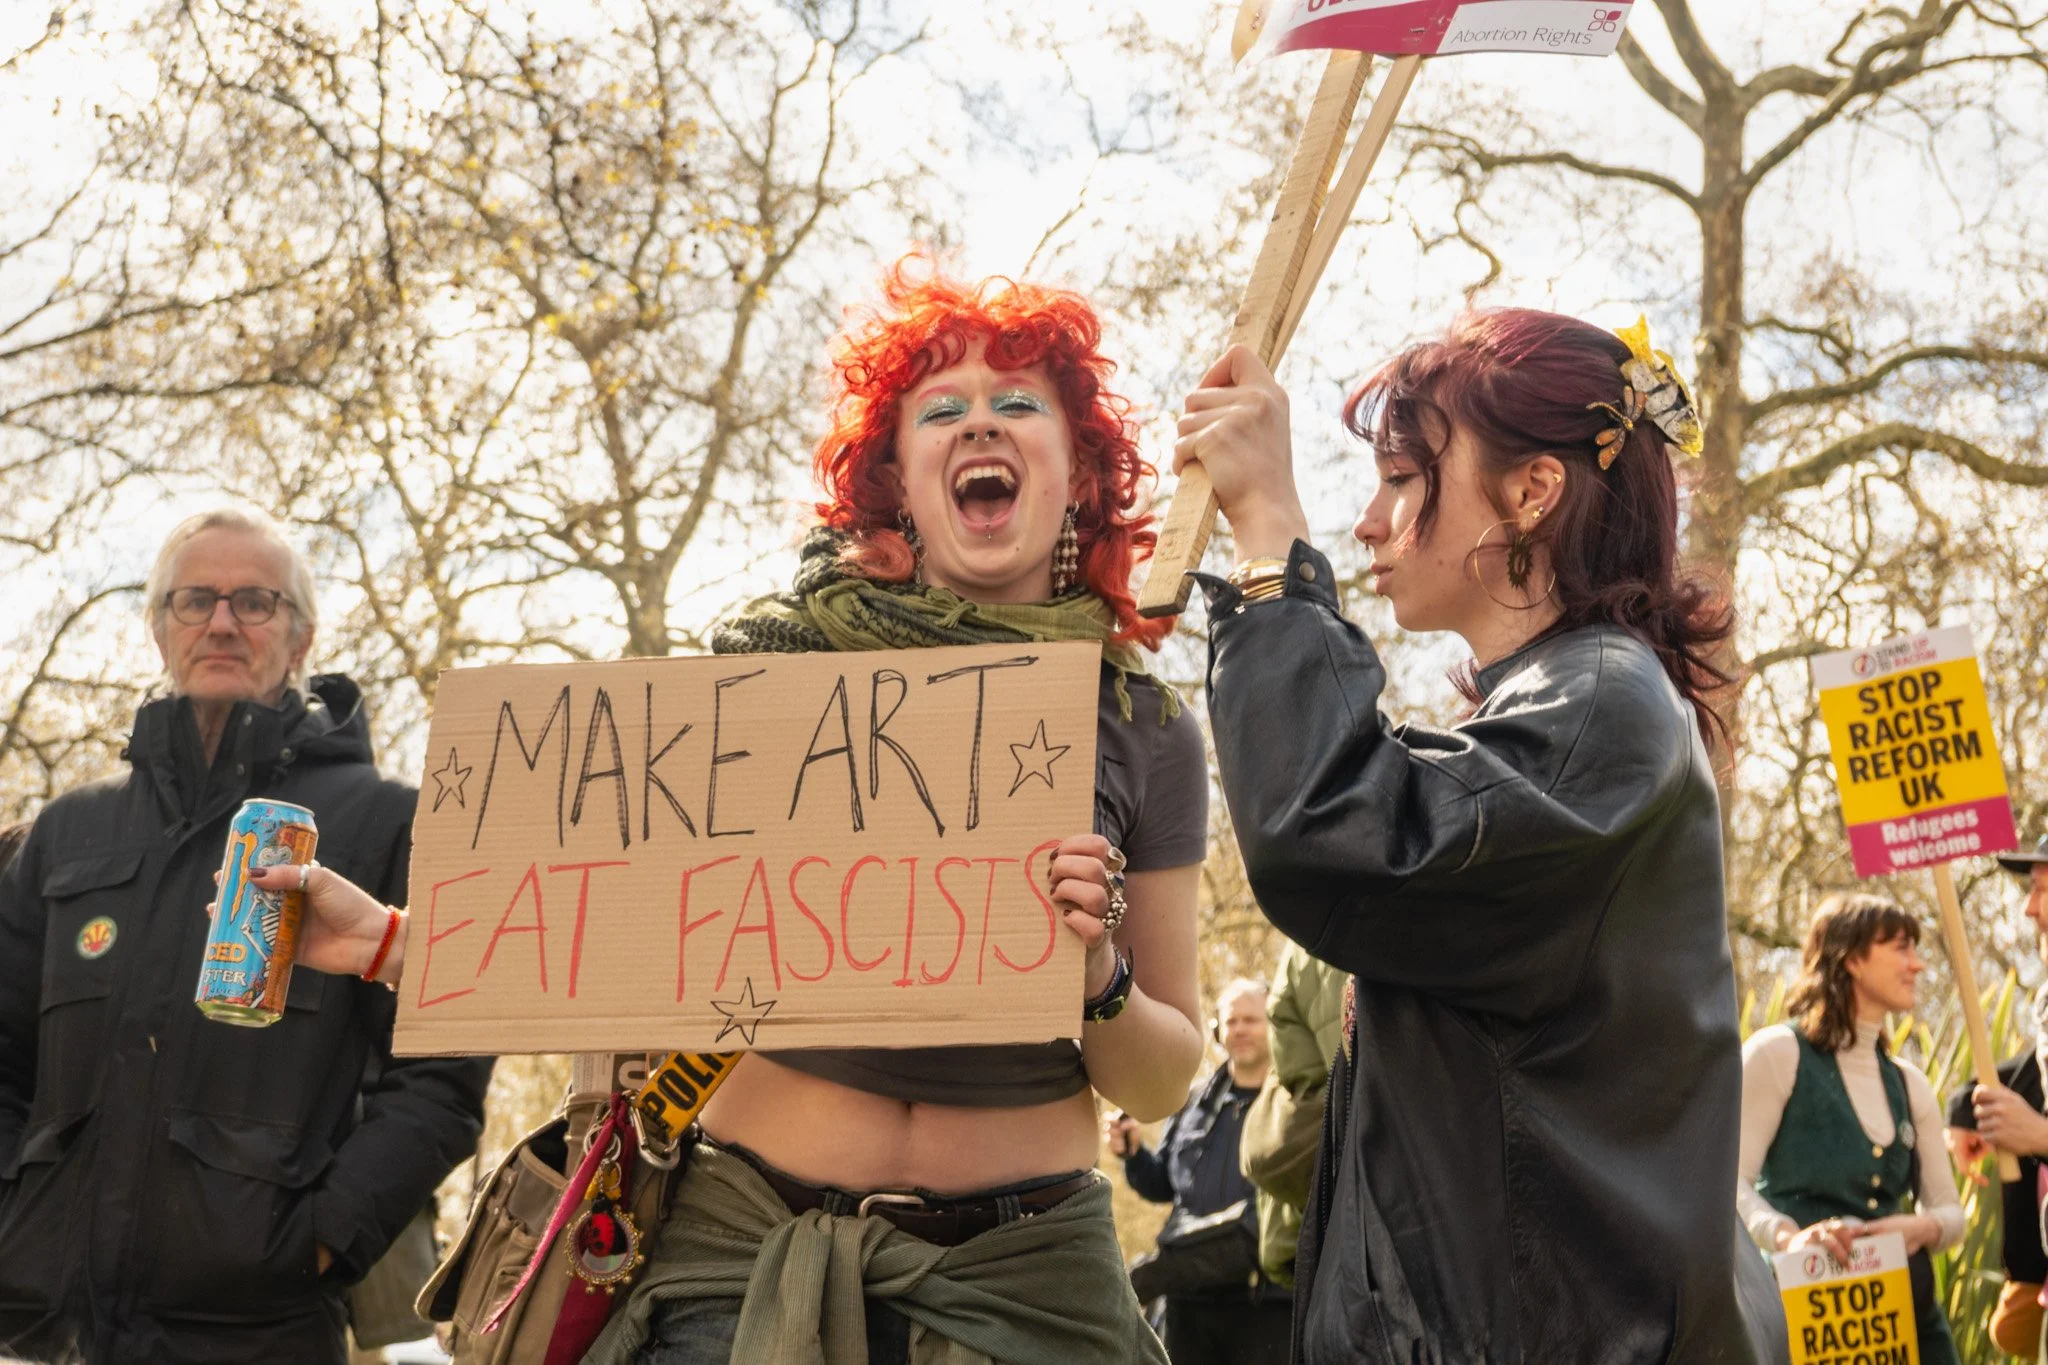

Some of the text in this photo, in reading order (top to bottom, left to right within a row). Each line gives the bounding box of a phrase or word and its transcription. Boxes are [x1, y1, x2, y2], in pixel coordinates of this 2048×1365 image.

[1451, 27, 1593, 46] Abortion Rights
[1858, 671, 1942, 714] STOP
[1848, 698, 1964, 750] RACIST
[472, 656, 1039, 850] MAKE ART
[1848, 730, 1982, 784] REFORM
[1899, 771, 1945, 808] UK
[1881, 808, 1979, 845] Refugees
[1889, 831, 1981, 867] welcome
[418, 860, 630, 1009] EAT
[676, 839, 1062, 1003] FASCISTS
[641, 1052, 737, 1131] POLI
[1809, 1280, 1884, 1318] STOP
[1803, 1311, 1899, 1356] RACIST
